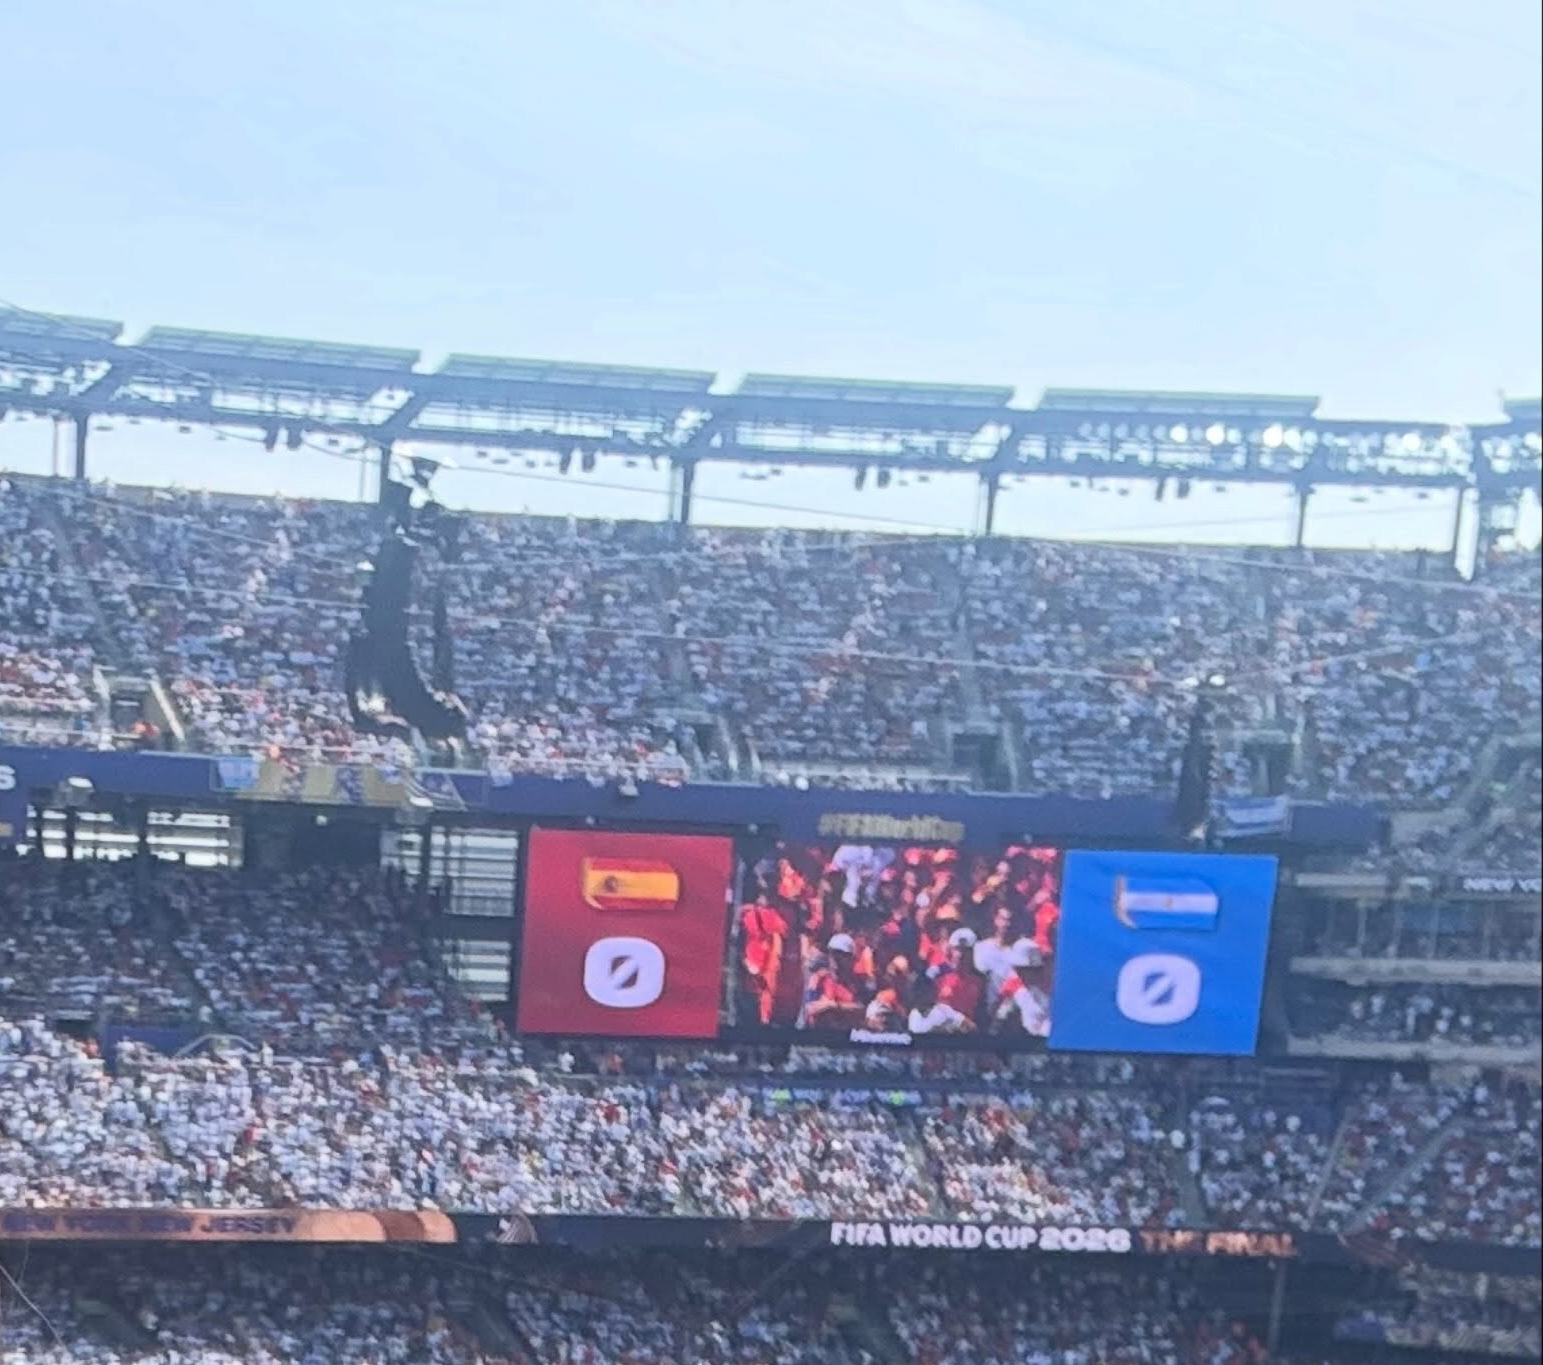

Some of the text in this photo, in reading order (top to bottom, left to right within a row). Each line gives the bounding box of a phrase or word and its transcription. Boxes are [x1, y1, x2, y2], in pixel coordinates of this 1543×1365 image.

[830, 1222, 887, 1247] FIFA
[889, 1222, 982, 1248] WORLD
[984, 1224, 1037, 1249] CUP
[1039, 1226, 1131, 1252] 2026
